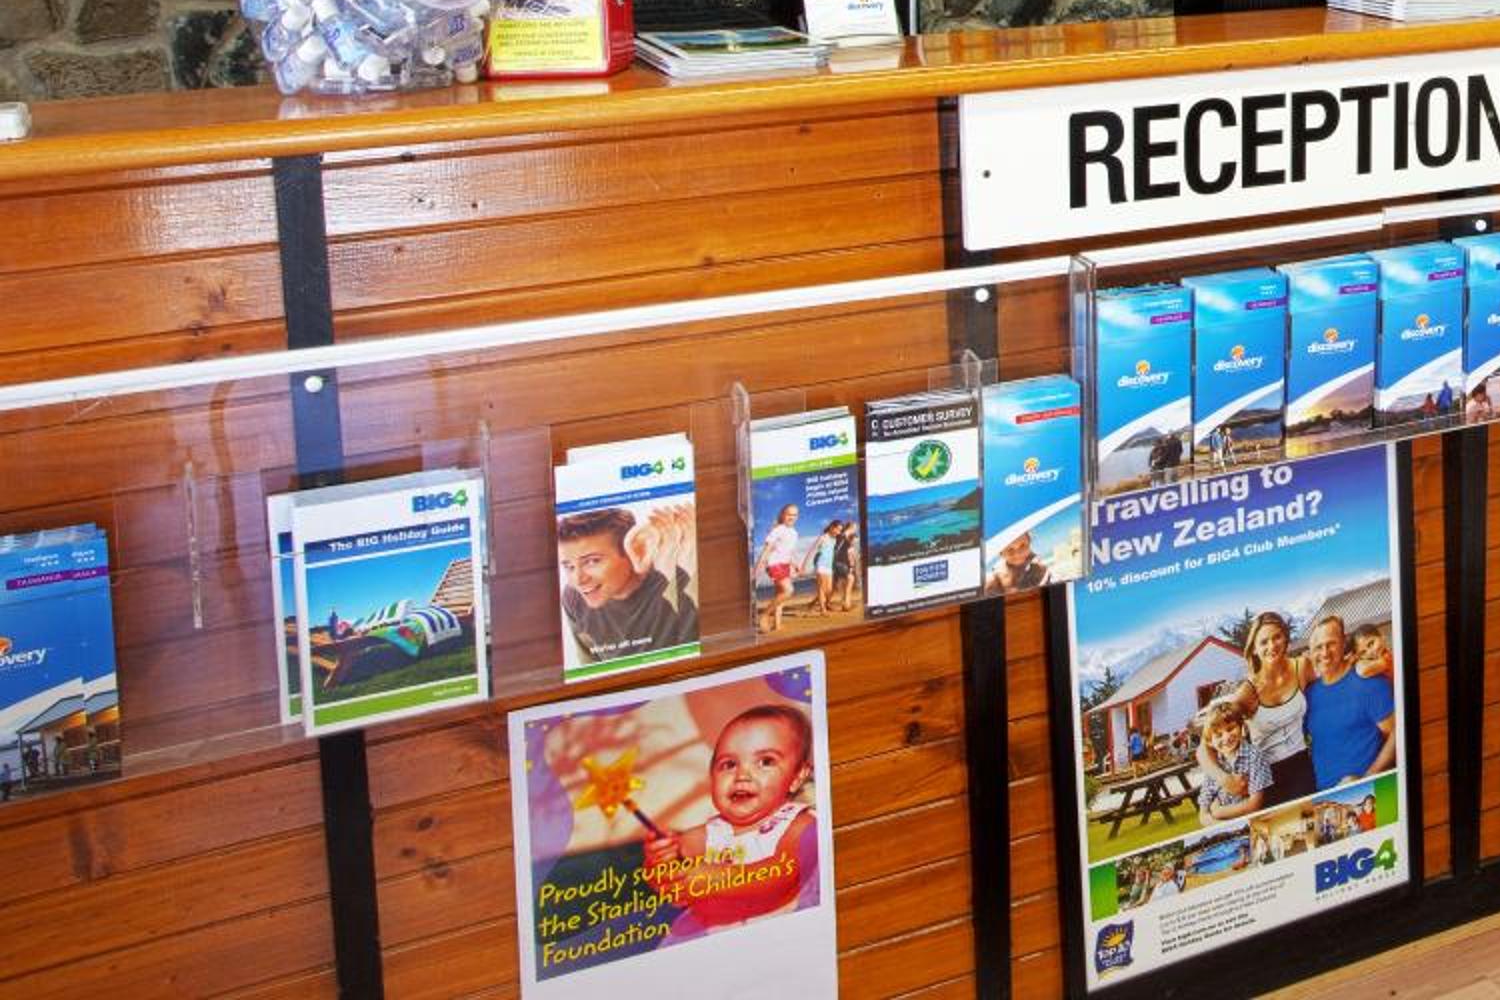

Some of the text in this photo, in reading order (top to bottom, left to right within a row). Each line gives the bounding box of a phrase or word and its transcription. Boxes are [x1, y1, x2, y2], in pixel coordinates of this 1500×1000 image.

[1401, 324, 1446, 341] discovery
[1307, 339, 1355, 354] discovery
[1213, 354, 1263, 373] discovery
[1117, 371, 1170, 389] discovery
[881, 413, 934, 430] CUSTOMER
[935, 407, 973, 421] SURVEY
[809, 432, 849, 451] BIG4
[620, 459, 665, 480] BIG4
[1004, 467, 1061, 486] discovery
[412, 489, 469, 513] BIG4
[1089, 464, 1293, 527] Travelling to
[330, 522, 466, 553] The BIG Holiday Guide
[1090, 490, 1324, 567] New Zealand?
[1087, 575, 1117, 594] 10%
[1120, 561, 1181, 586] discount
[1183, 554, 1204, 571] for
[1207, 548, 1241, 566] BIG4
[1244, 540, 1274, 557] Club
[539, 843, 744, 908] Proudly supporting
[1314, 836, 1398, 894] BIG4
[538, 852, 796, 938] the Starlight Children's
[541, 920, 673, 968] Foundation
